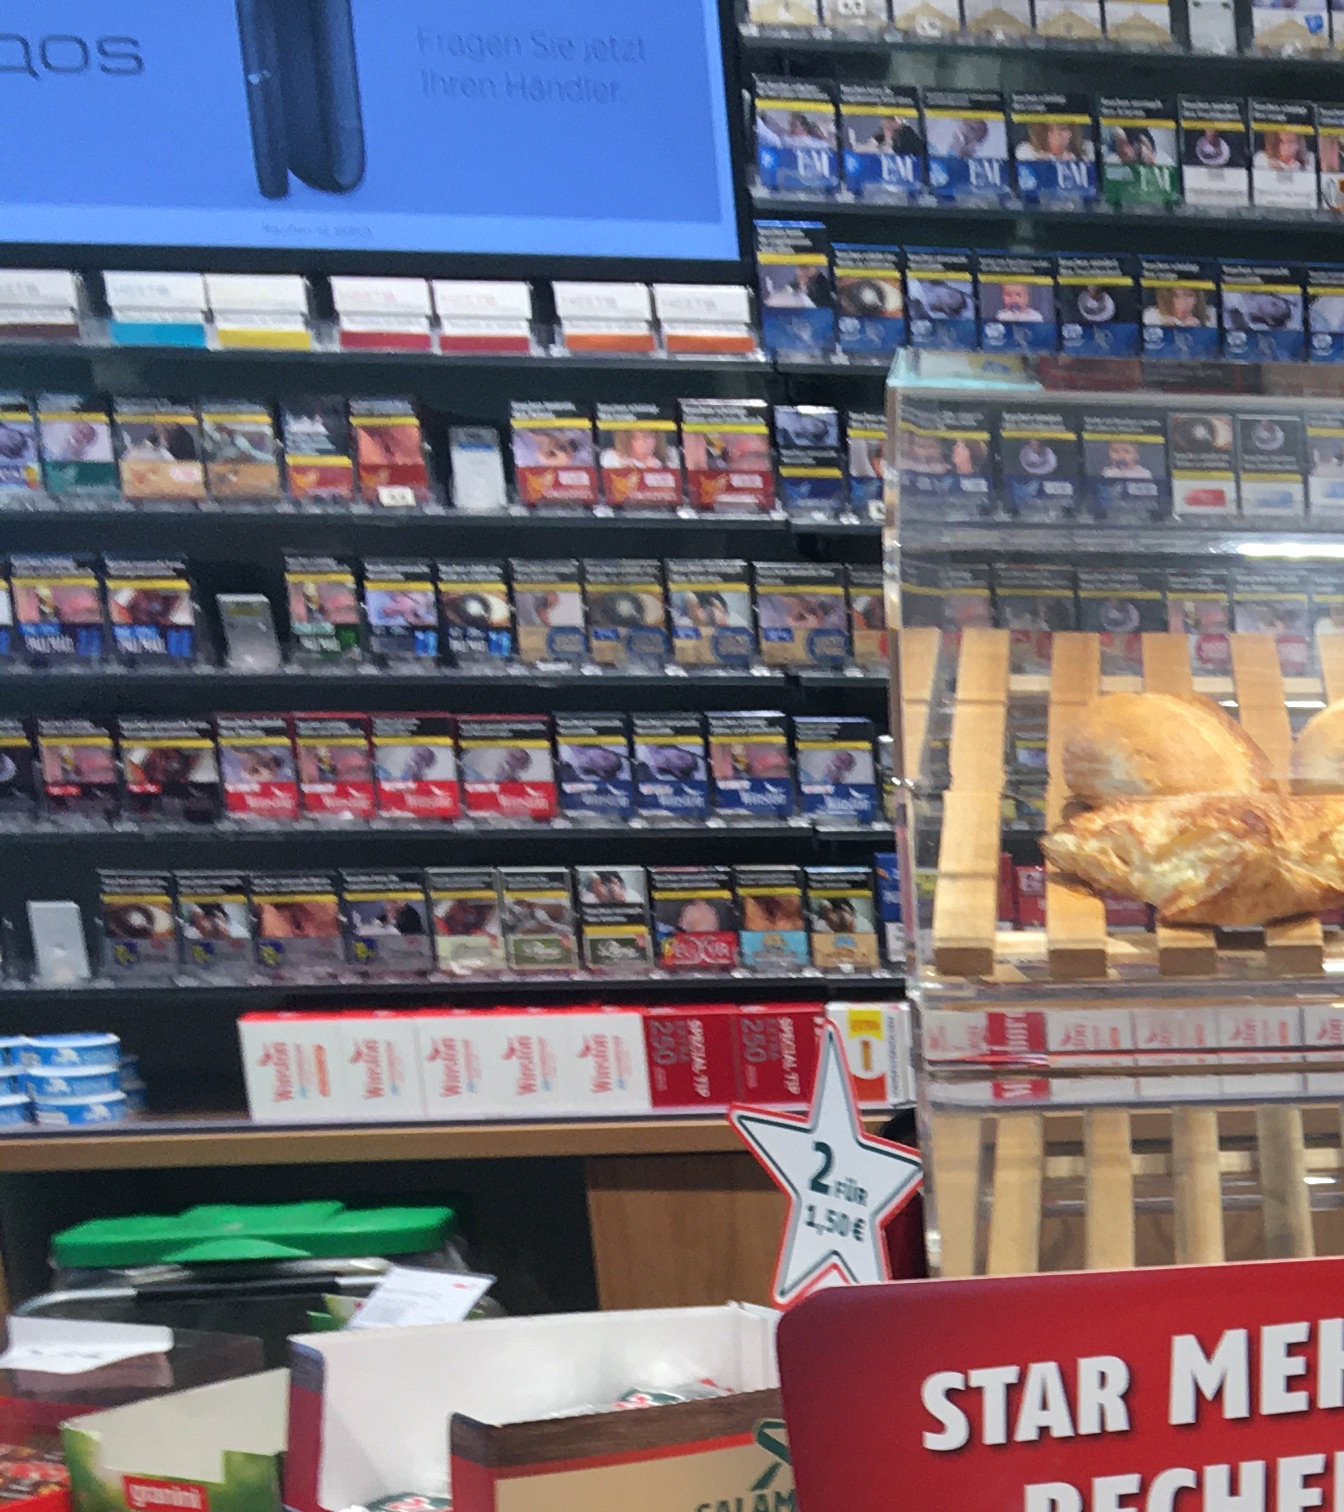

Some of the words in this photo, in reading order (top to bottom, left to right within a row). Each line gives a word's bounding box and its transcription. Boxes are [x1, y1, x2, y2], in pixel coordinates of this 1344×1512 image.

[417, 26, 522, 62] Fragen
[530, 29, 575, 60] Sie
[583, 34, 647, 65] jetzt
[420, 68, 498, 99] Ihren
[651, 1019, 677, 1066] 250
[741, 1018, 767, 1063] 250
[810, 1141, 833, 1194] 2
[834, 1176, 869, 1207] FÜR
[921, 1355, 1131, 1452] STAR
